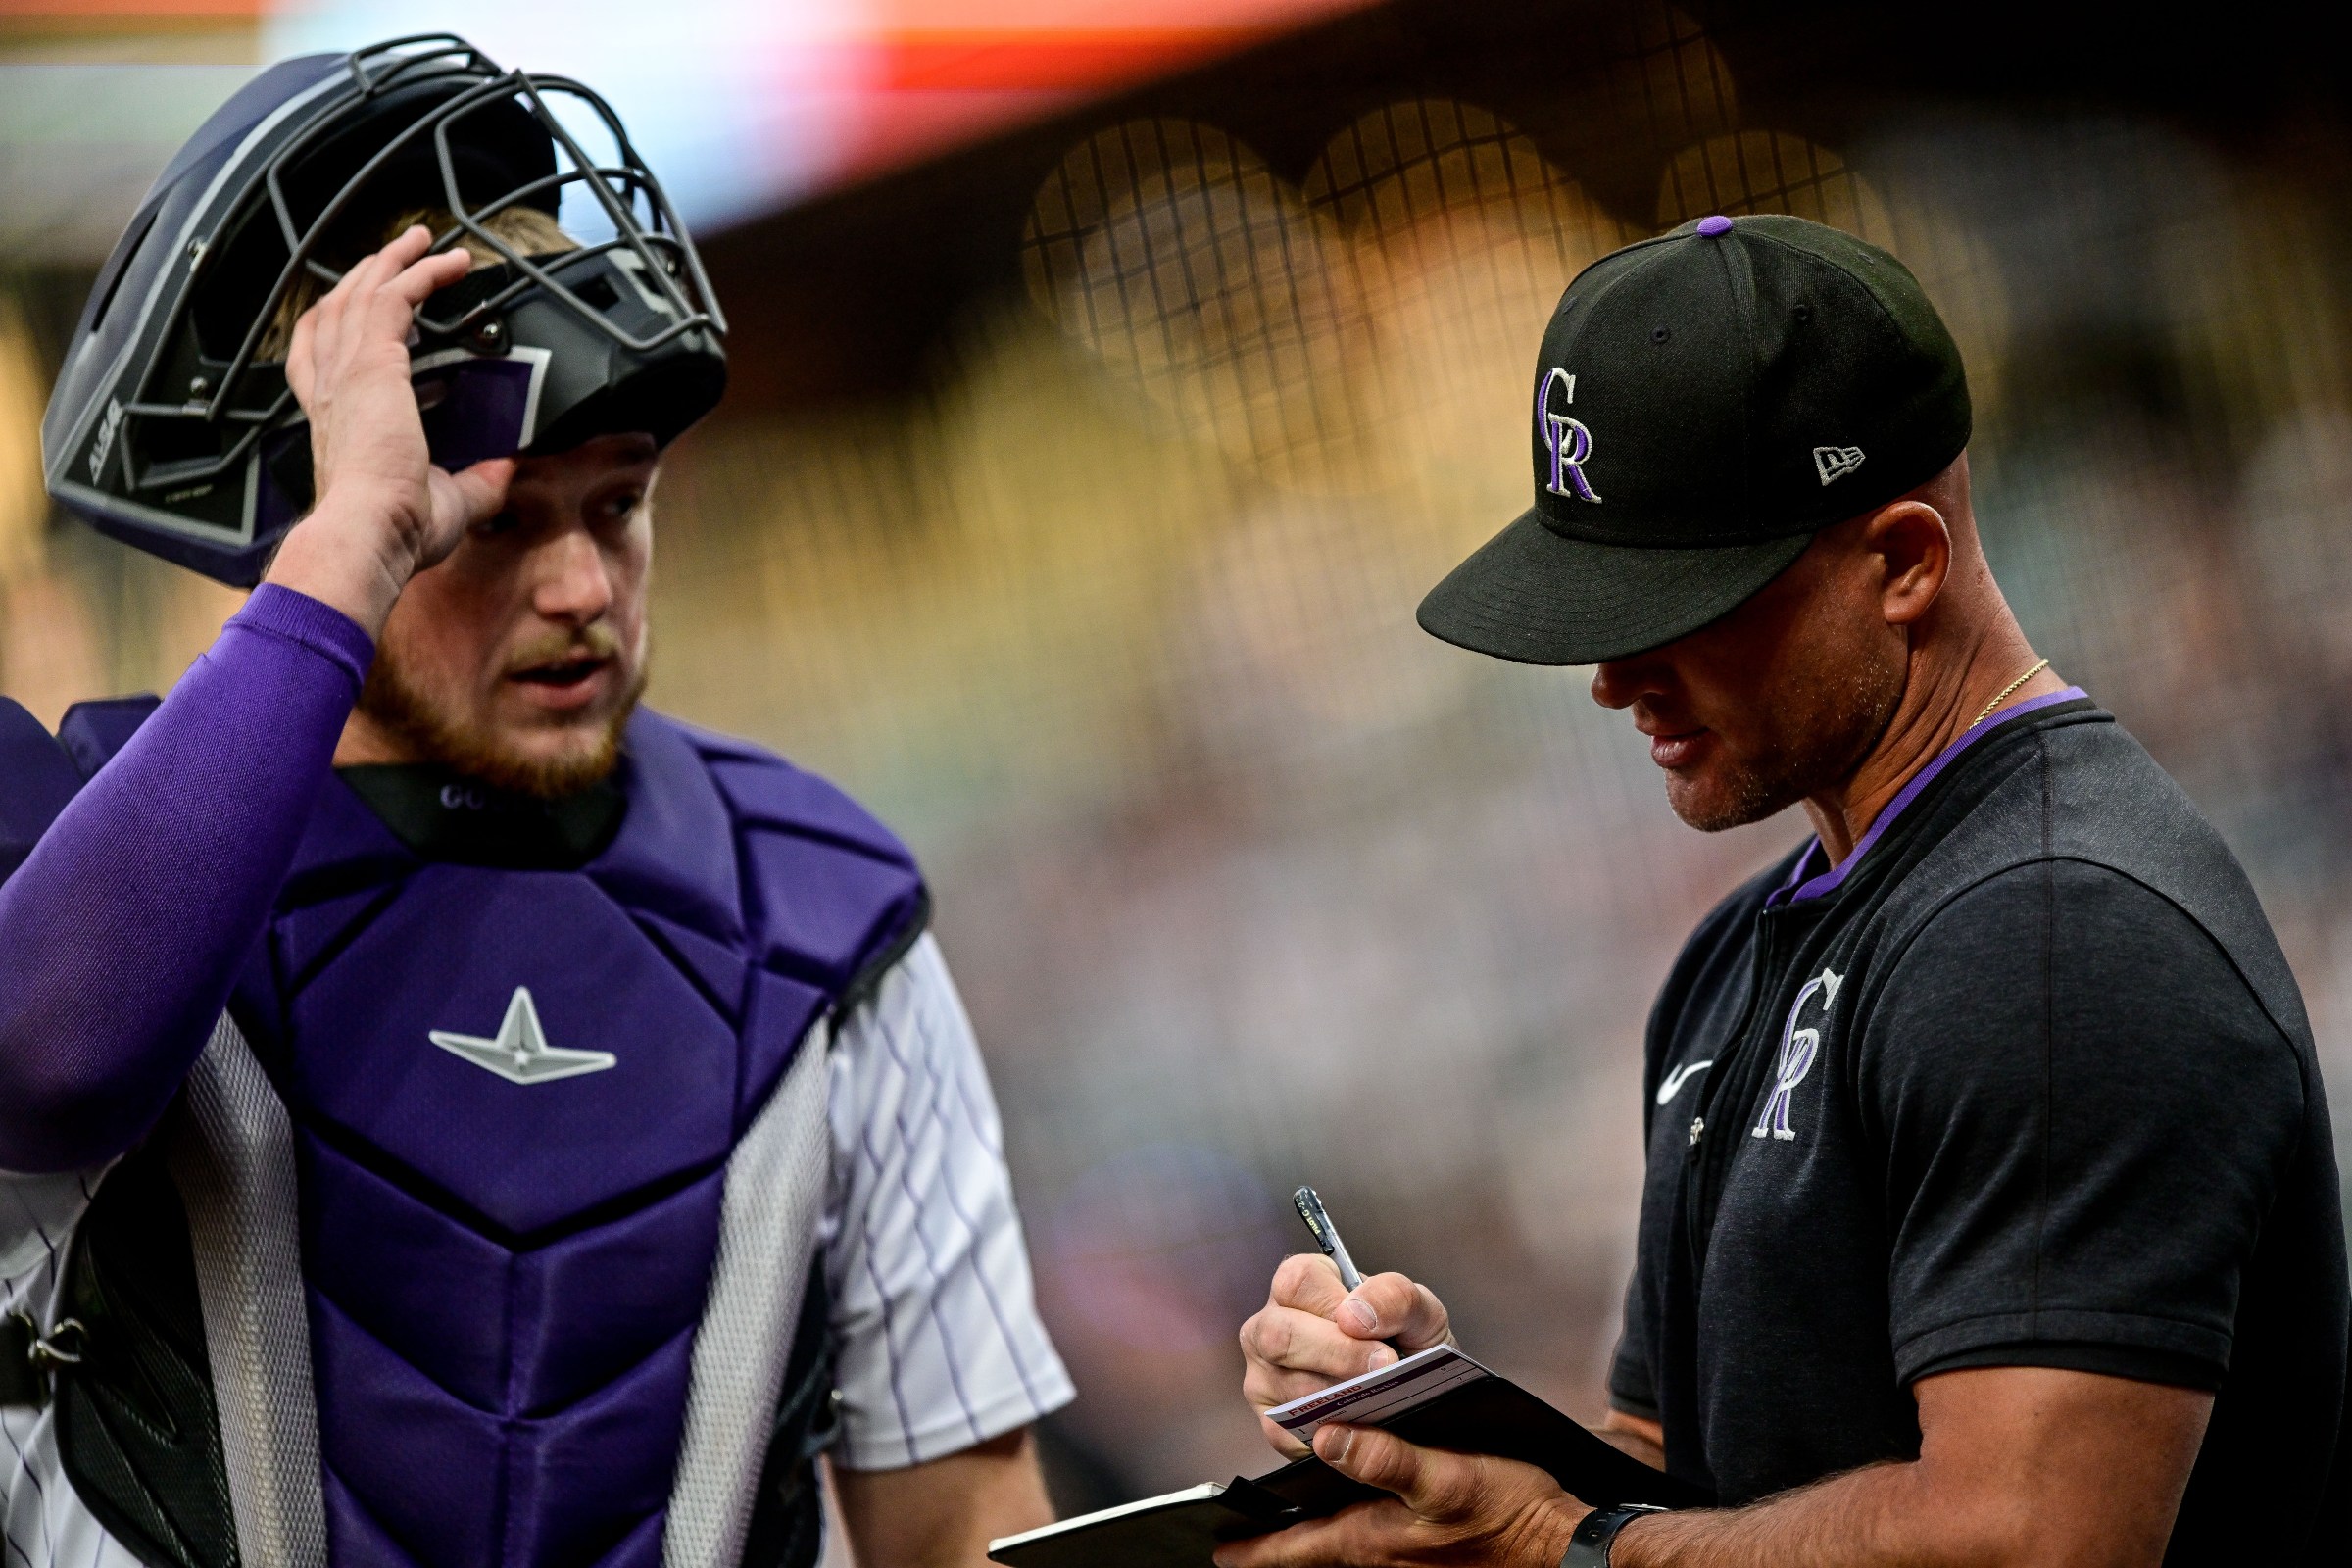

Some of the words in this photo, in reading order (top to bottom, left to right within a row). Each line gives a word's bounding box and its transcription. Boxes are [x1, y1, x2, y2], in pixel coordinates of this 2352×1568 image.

[1298, 1200, 1310, 1217] G-2
[1305, 1216, 1322, 1235] PILOT
[1287, 1385, 1363, 1417] FREELAND
[1337, 1391, 1371, 1407] Colorado
[1371, 1380, 1399, 1394] Rockies
